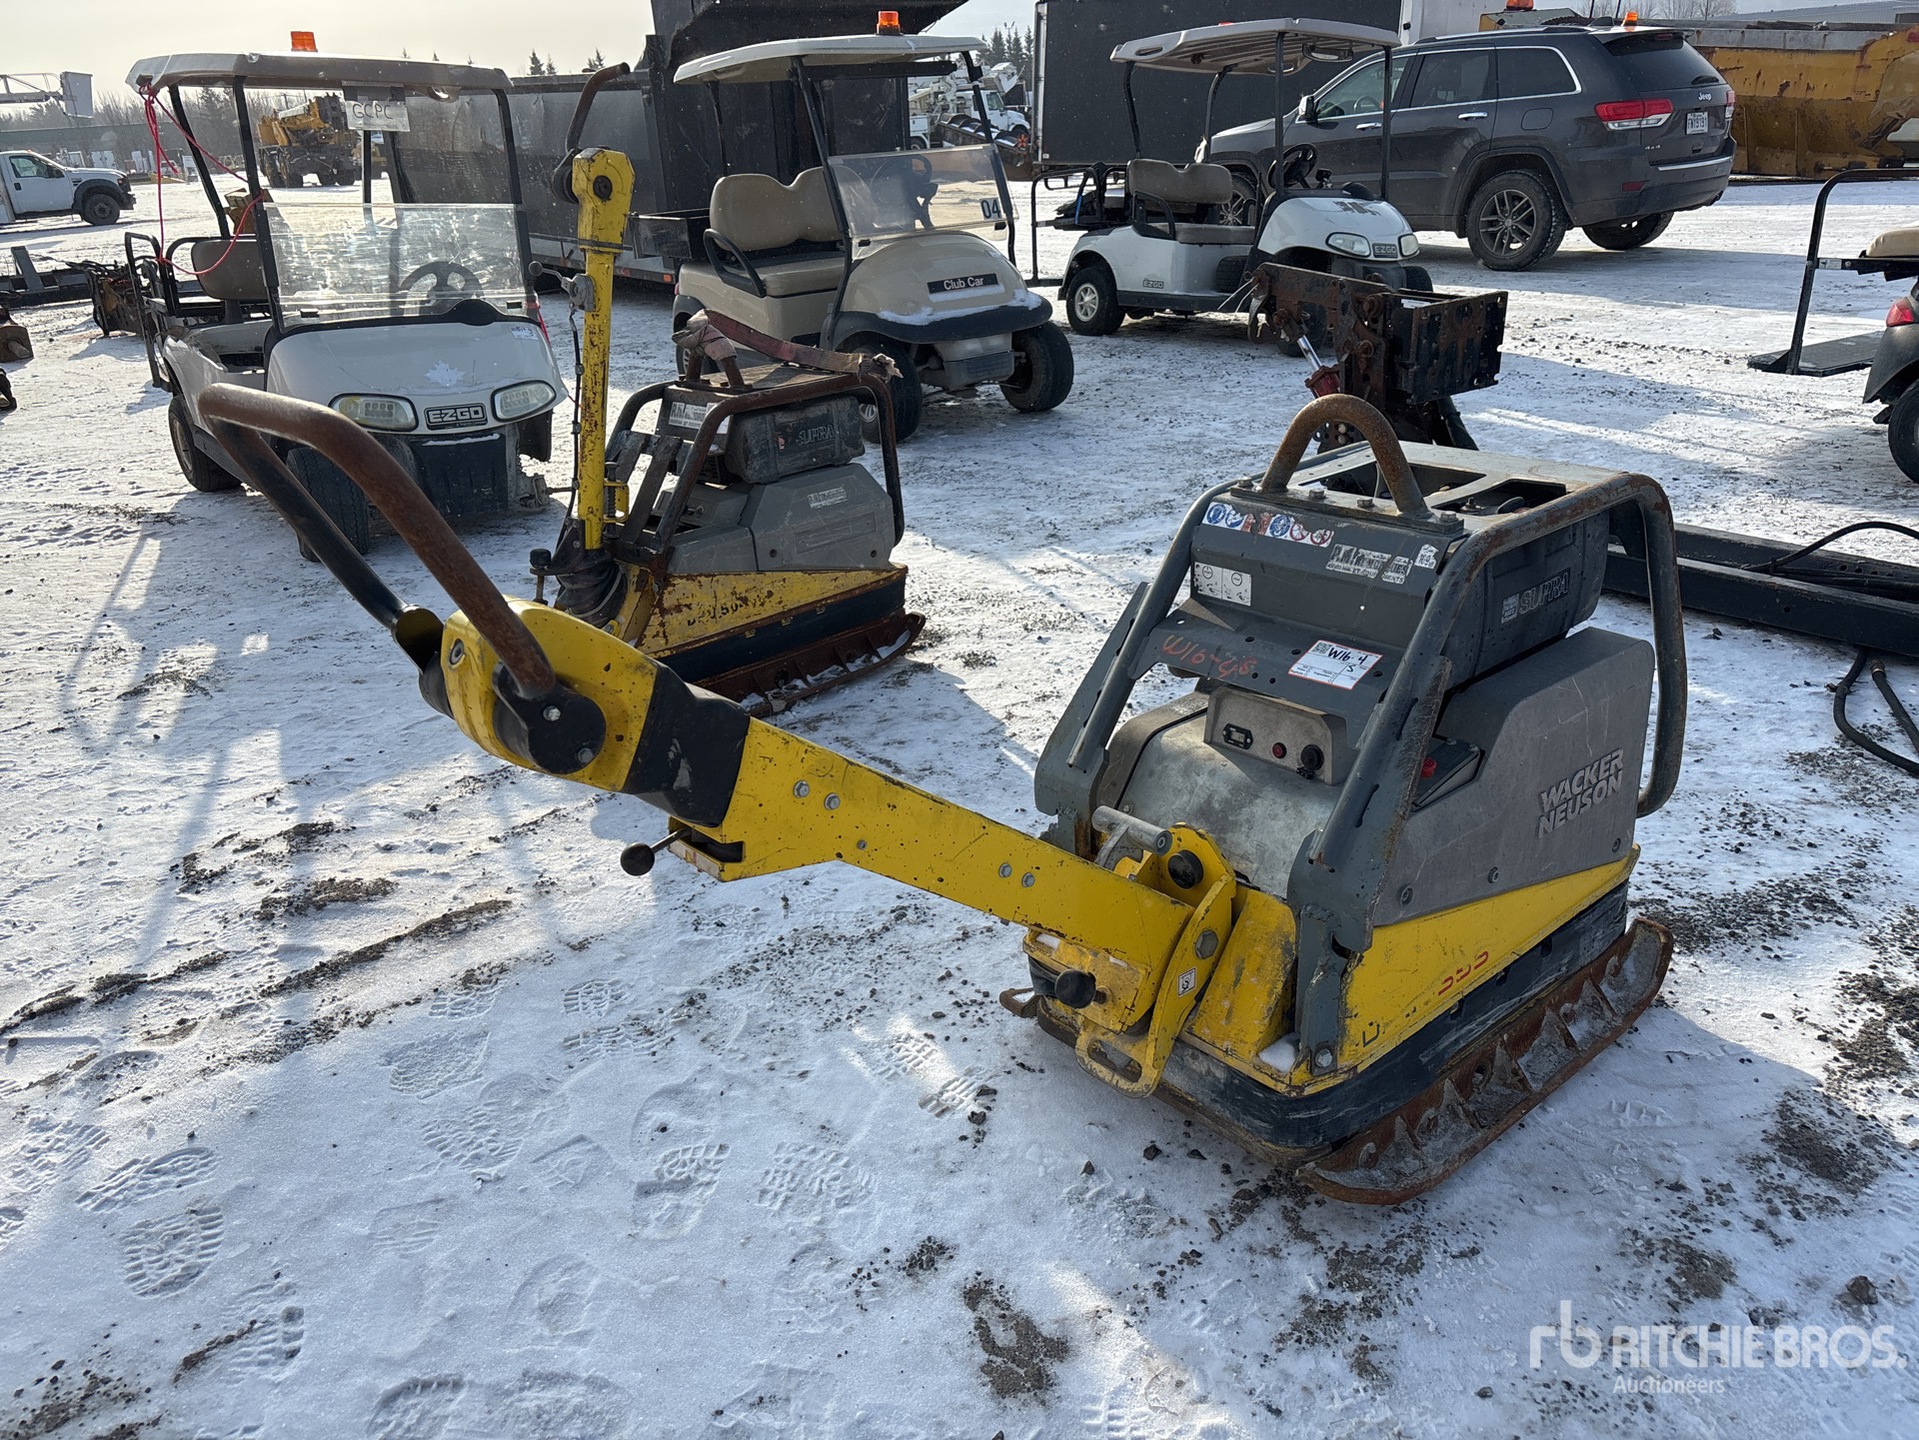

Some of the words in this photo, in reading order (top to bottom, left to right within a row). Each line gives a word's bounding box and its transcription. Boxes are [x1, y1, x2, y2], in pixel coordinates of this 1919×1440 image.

[1698, 93, 1711, 101] Jeep
[352, 103, 393, 119] GCPC
[981, 200, 1001, 219] 04
[943, 280, 966, 290] Club
[967, 277, 984, 287] Car
[1519, 572, 1569, 615] SUPRA
[1540, 748, 1624, 813] WACKER
[1538, 770, 1623, 839] NEUSON
